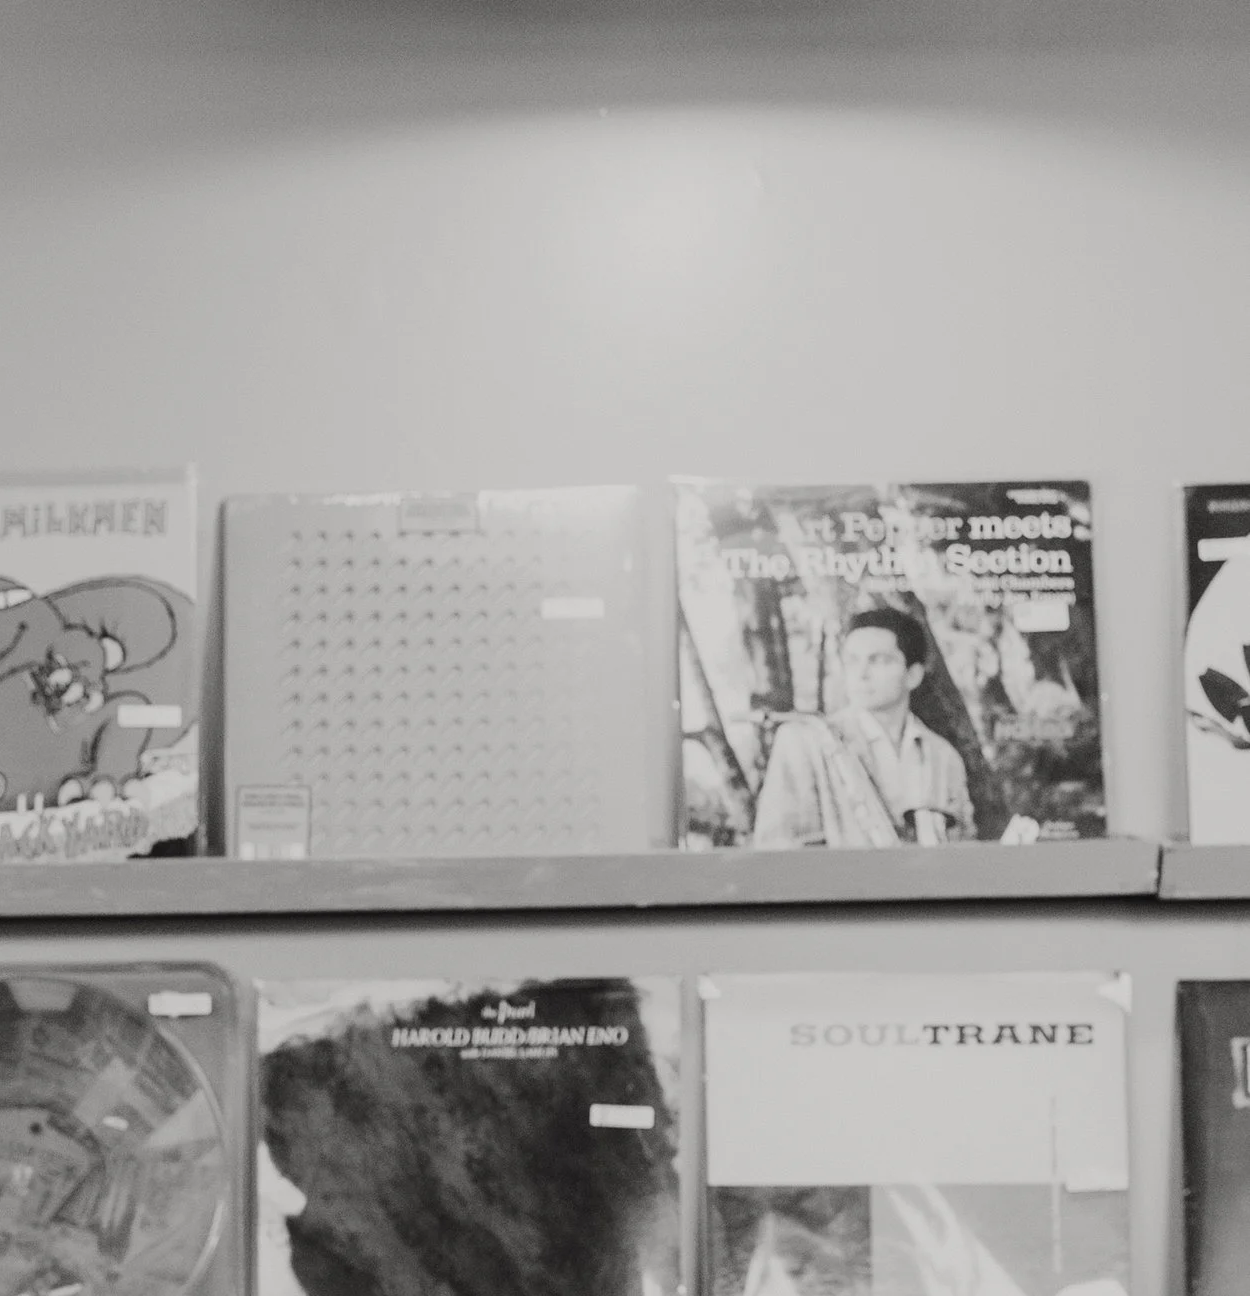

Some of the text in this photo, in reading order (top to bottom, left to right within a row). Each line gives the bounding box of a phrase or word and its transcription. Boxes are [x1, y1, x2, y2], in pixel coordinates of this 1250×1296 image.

[970, 512, 1073, 541] meets
[722, 548, 792, 579] The
[946, 543, 1074, 574] Section
[391, 1026, 470, 1047] HAROLD
[586, 1026, 630, 1047] ENO
[790, 1023, 1094, 1045] SOULTRANE
